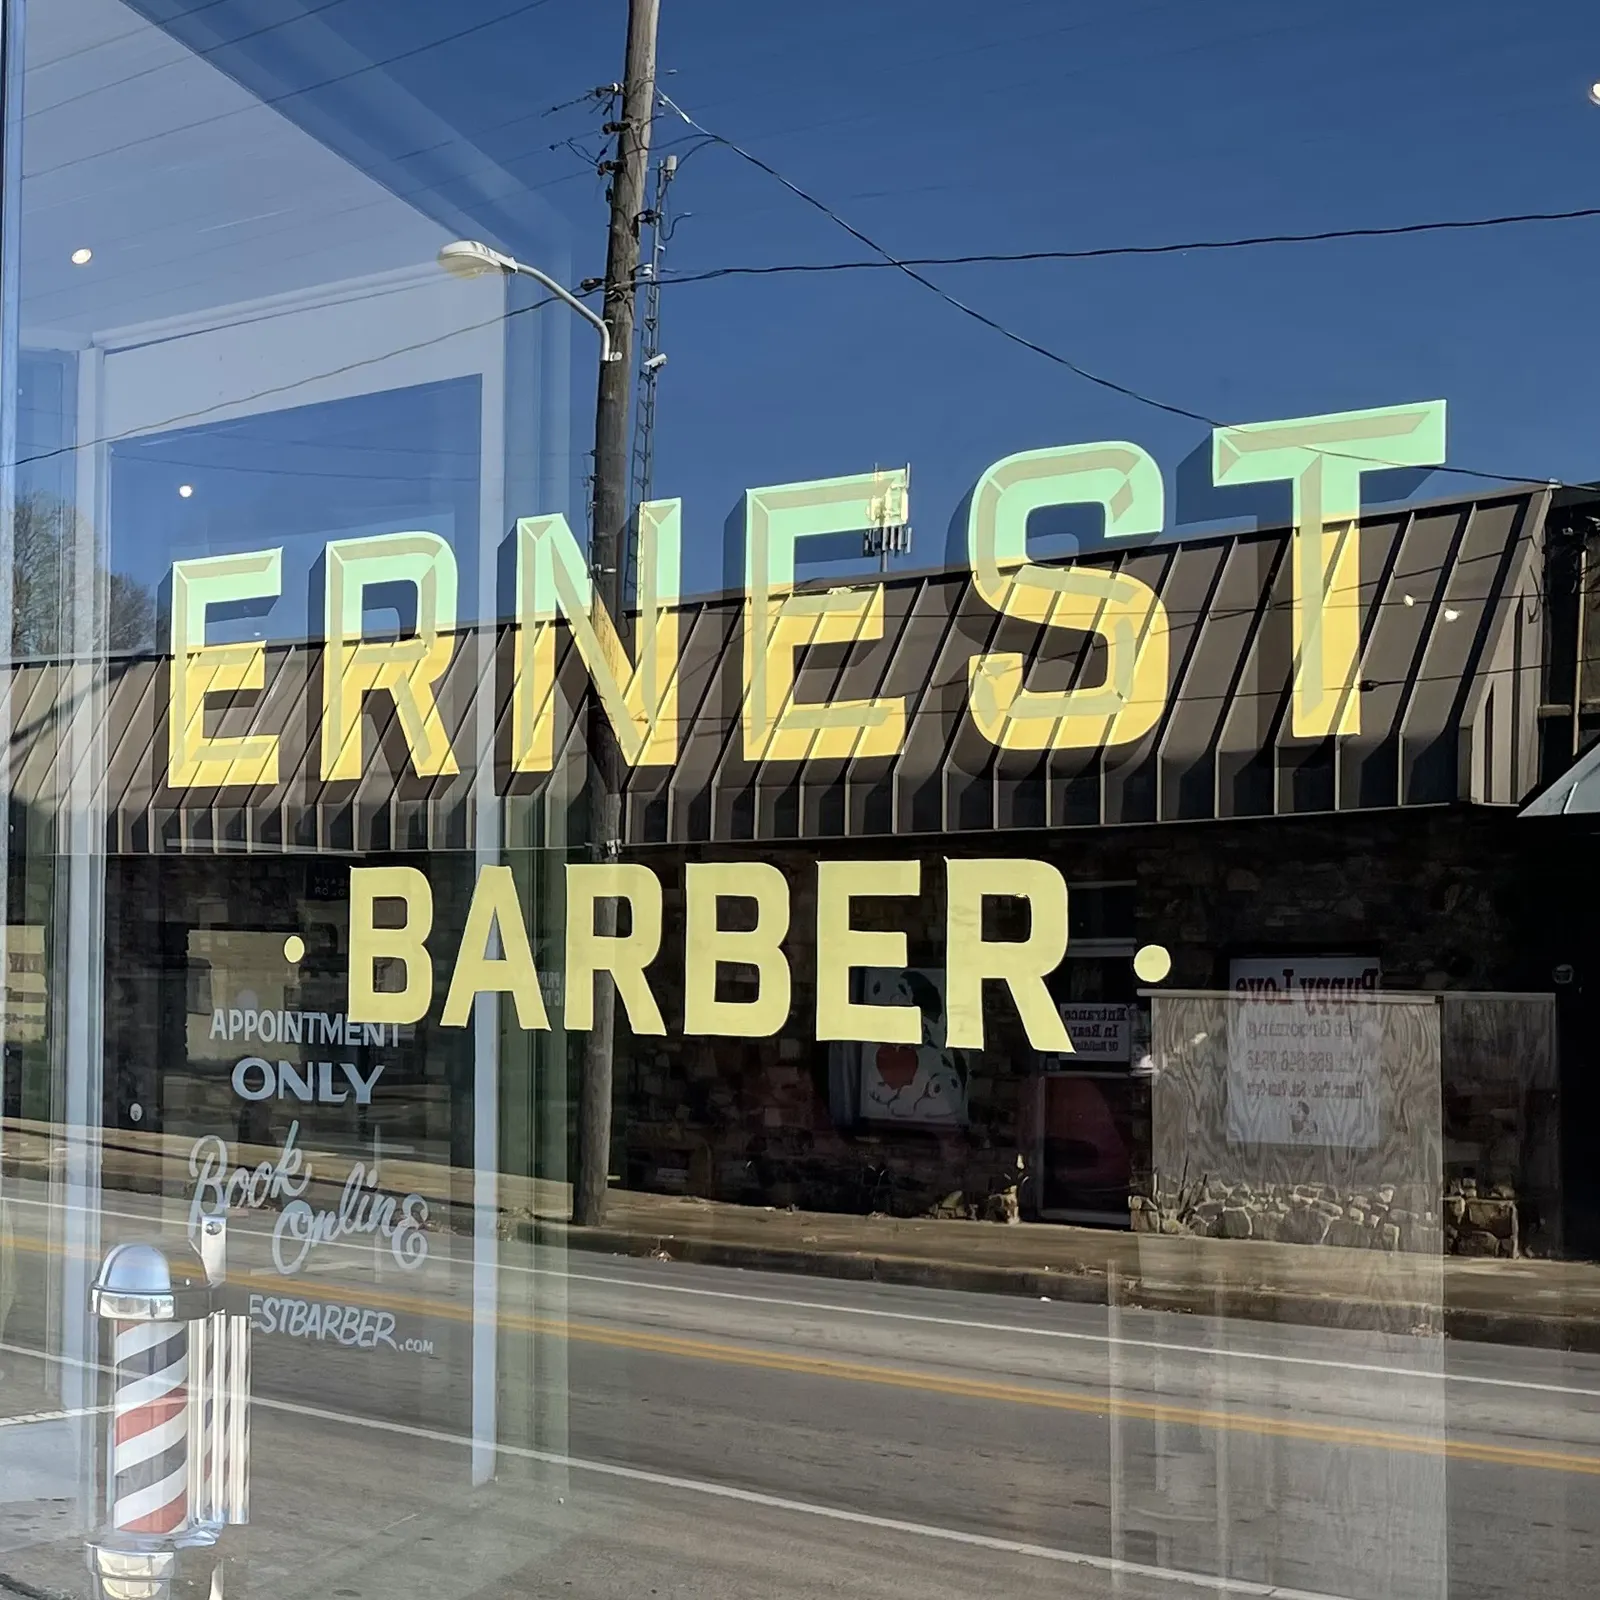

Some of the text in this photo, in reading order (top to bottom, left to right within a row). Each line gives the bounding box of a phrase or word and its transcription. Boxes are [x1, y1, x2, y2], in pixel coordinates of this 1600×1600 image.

[167, 399, 1448, 790] ERNEST
[347, 857, 1075, 1054] BARBER
[231, 1057, 385, 1105] ONLY
[187, 1119, 313, 1241] Book
